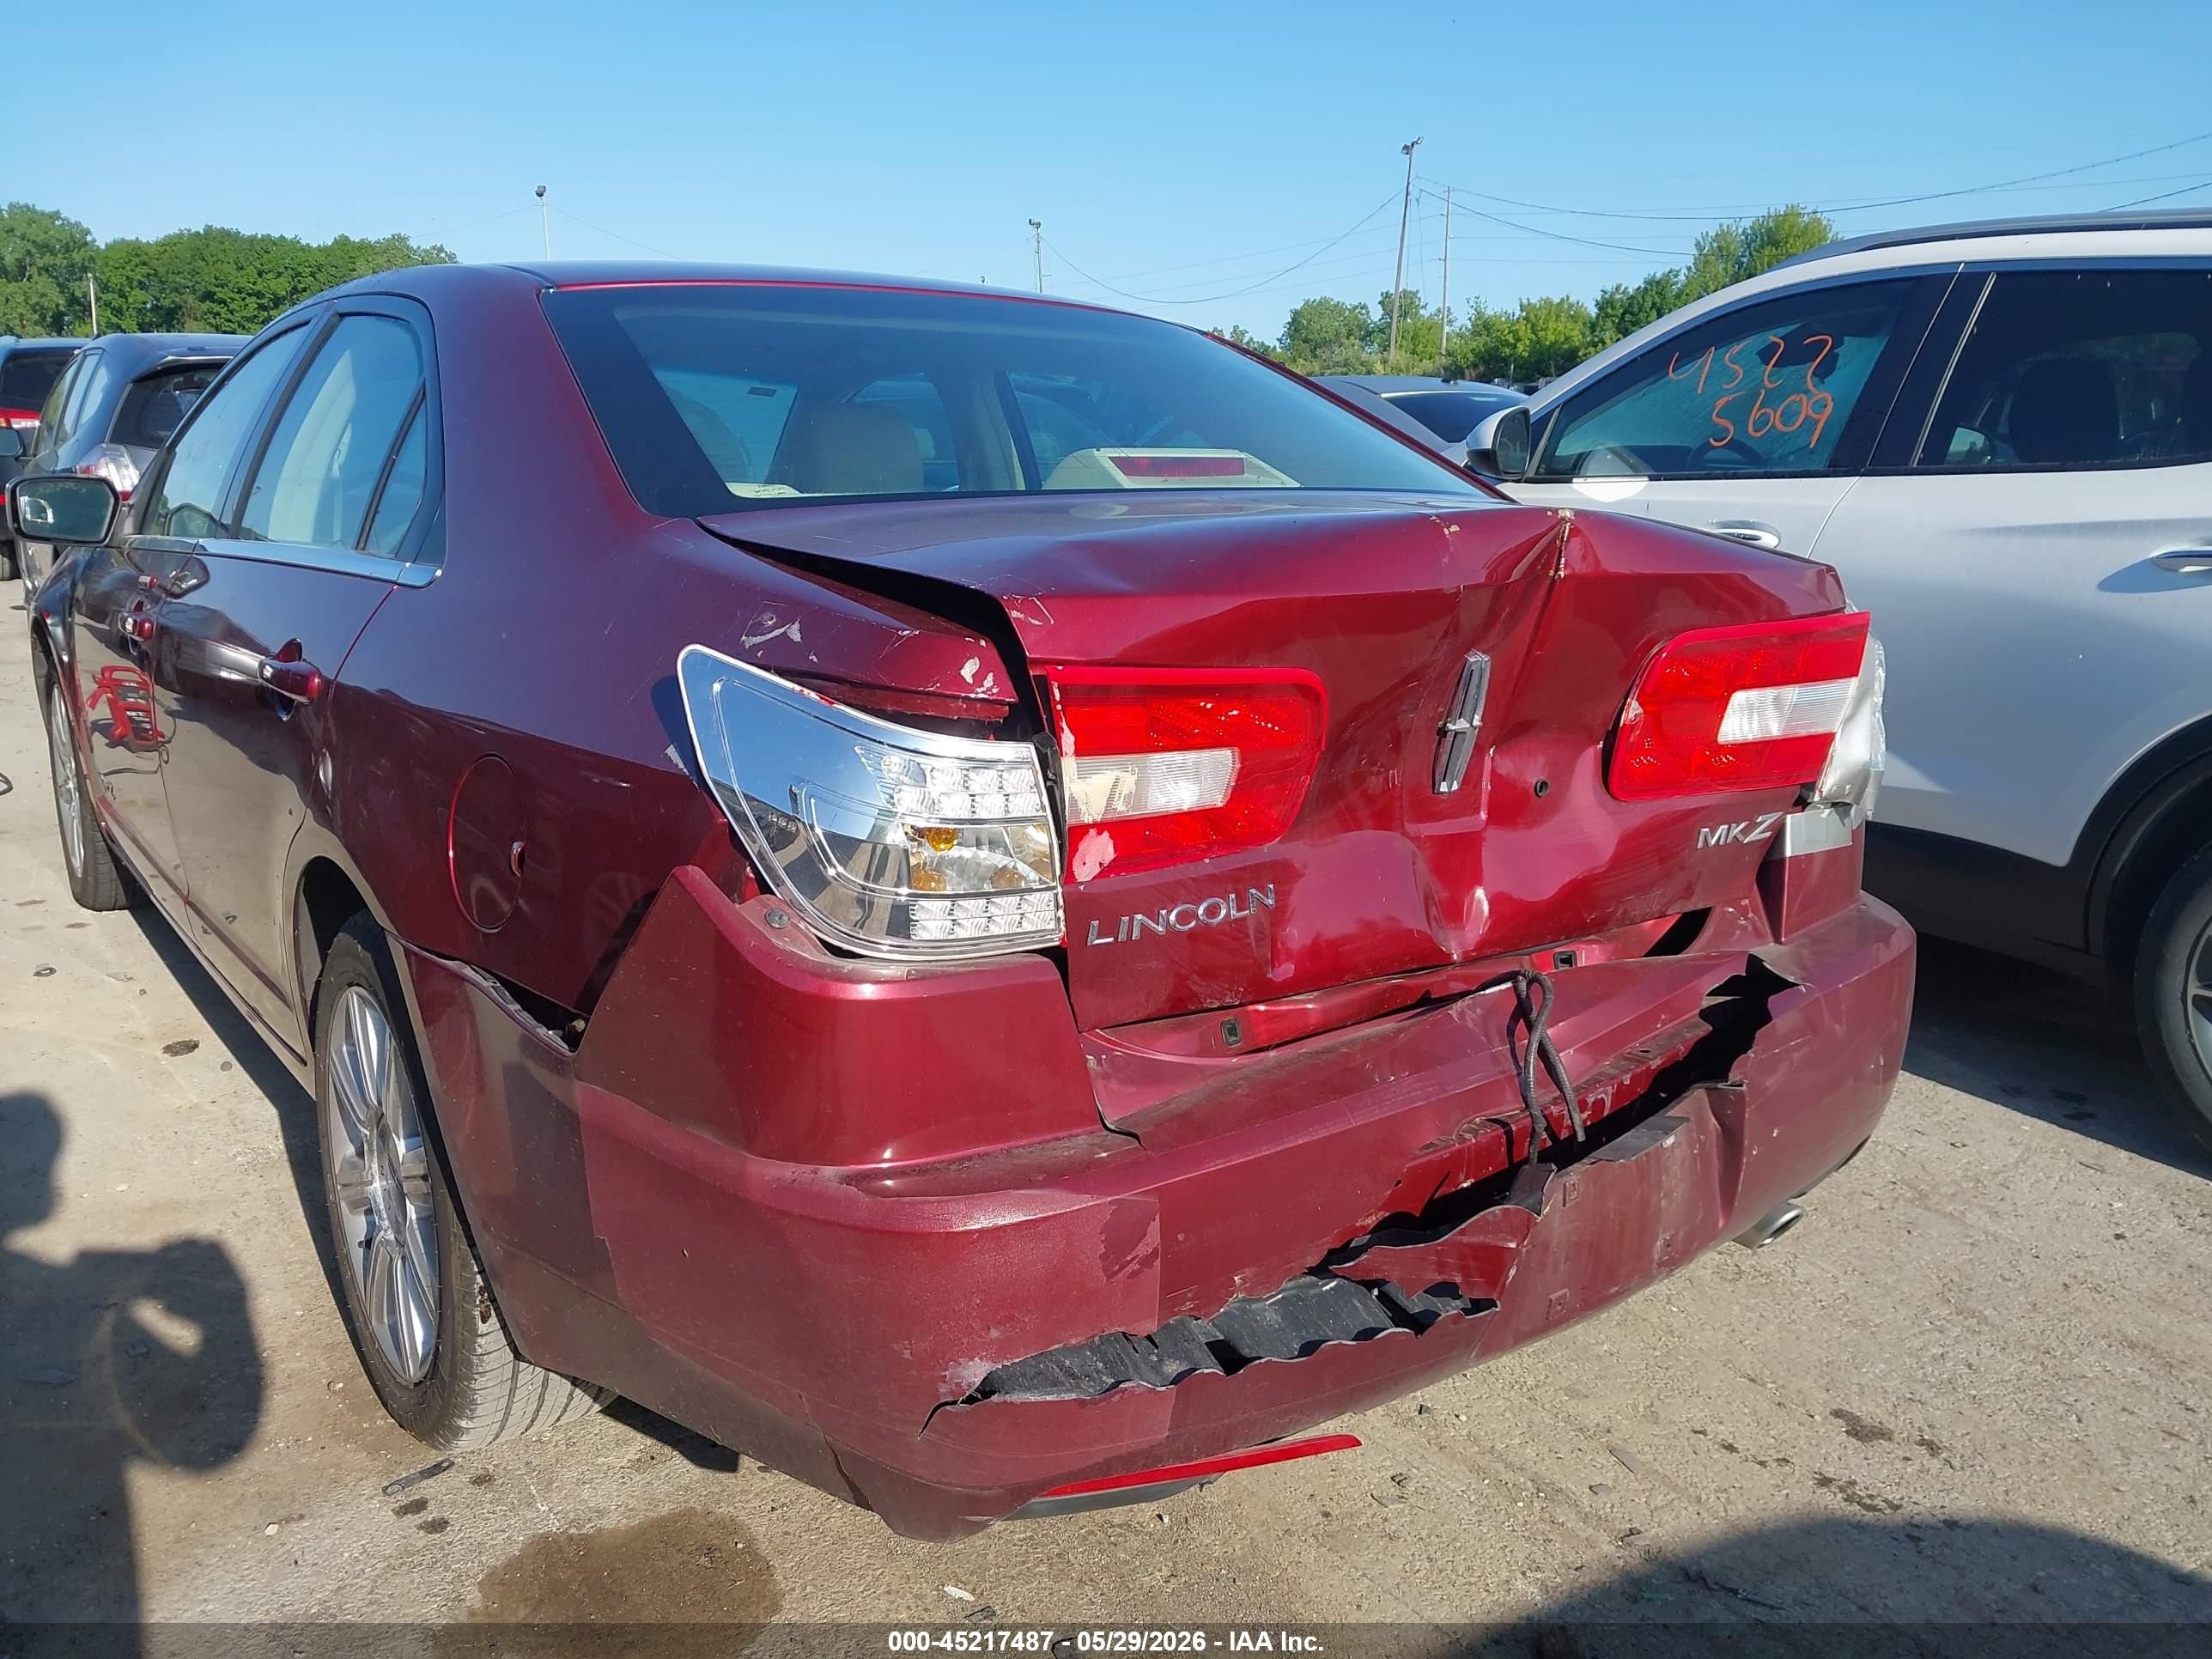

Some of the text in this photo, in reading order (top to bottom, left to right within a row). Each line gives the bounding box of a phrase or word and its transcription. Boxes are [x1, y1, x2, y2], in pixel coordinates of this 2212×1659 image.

[1710, 389, 1834, 448] 5609
[1697, 811, 1784, 849] MKZ
[1086, 884, 1275, 946] LINCOLN
